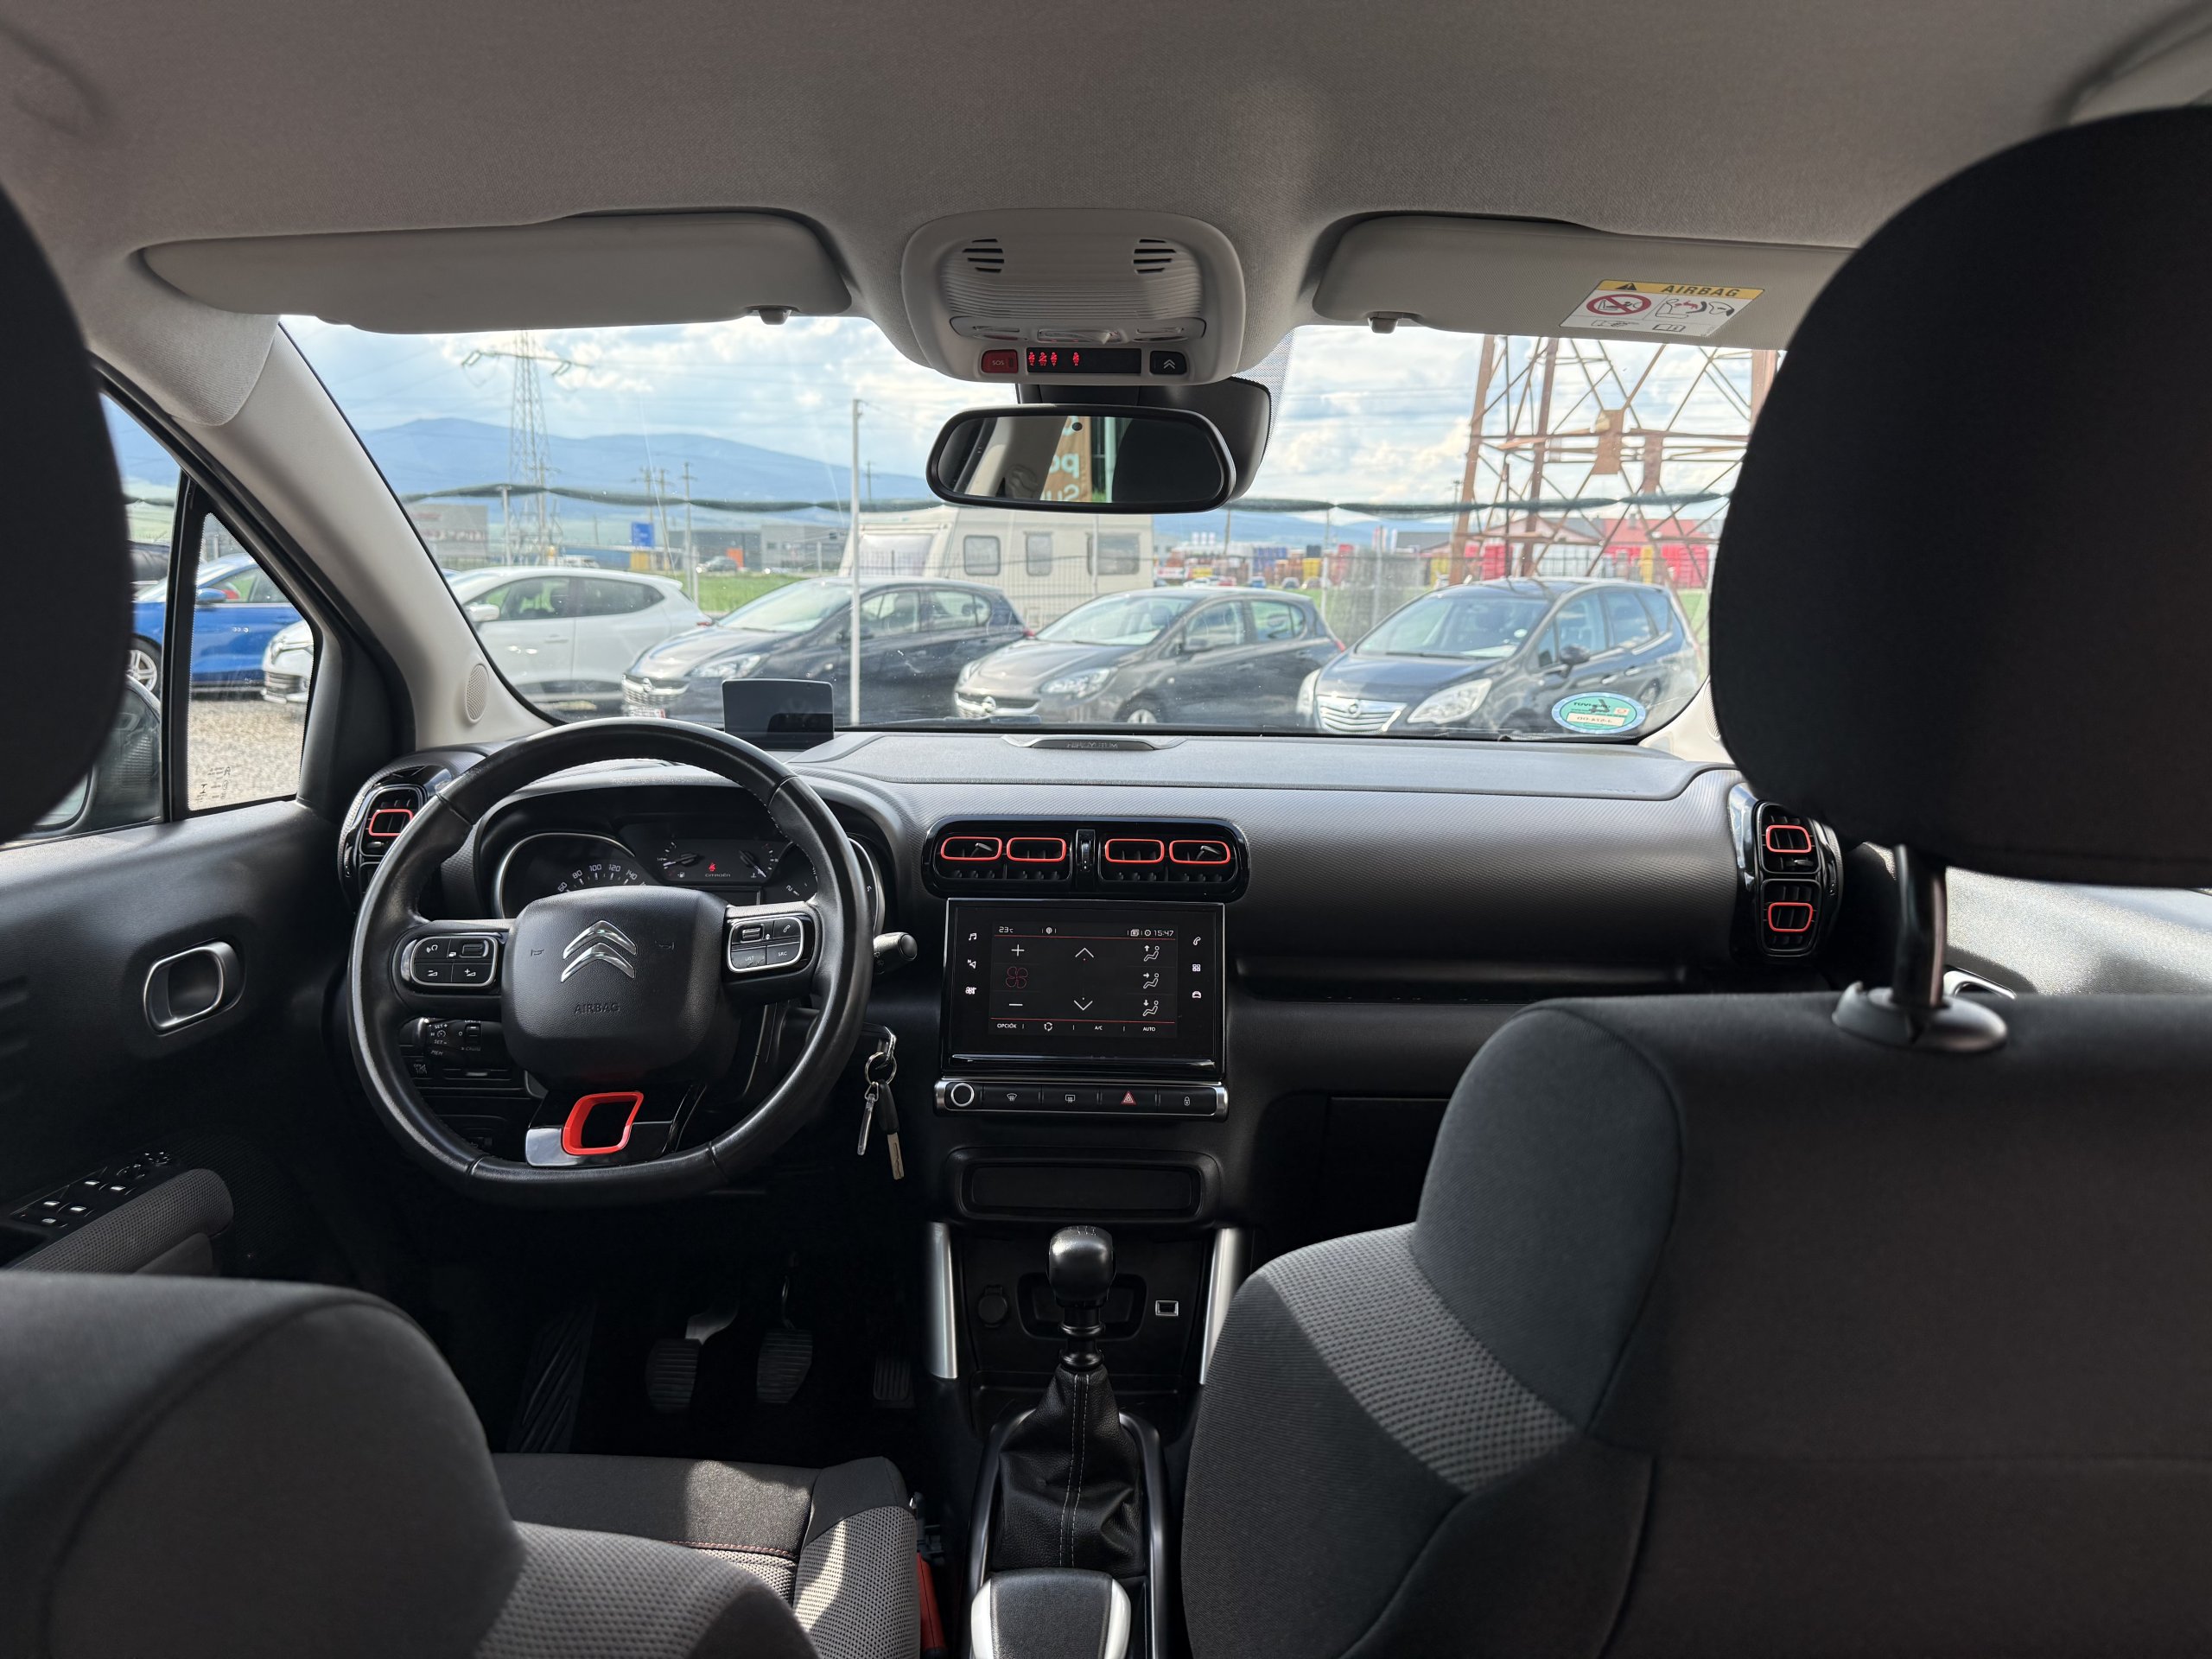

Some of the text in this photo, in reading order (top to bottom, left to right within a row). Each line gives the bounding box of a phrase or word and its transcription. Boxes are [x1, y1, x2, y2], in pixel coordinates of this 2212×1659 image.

[1661, 285, 1740, 297] AIRBAG
[572, 869, 582, 879] 80
[626, 869, 638, 880] 140
[557, 881, 568, 892] 60
[575, 1002, 620, 1014] AIRBAG
